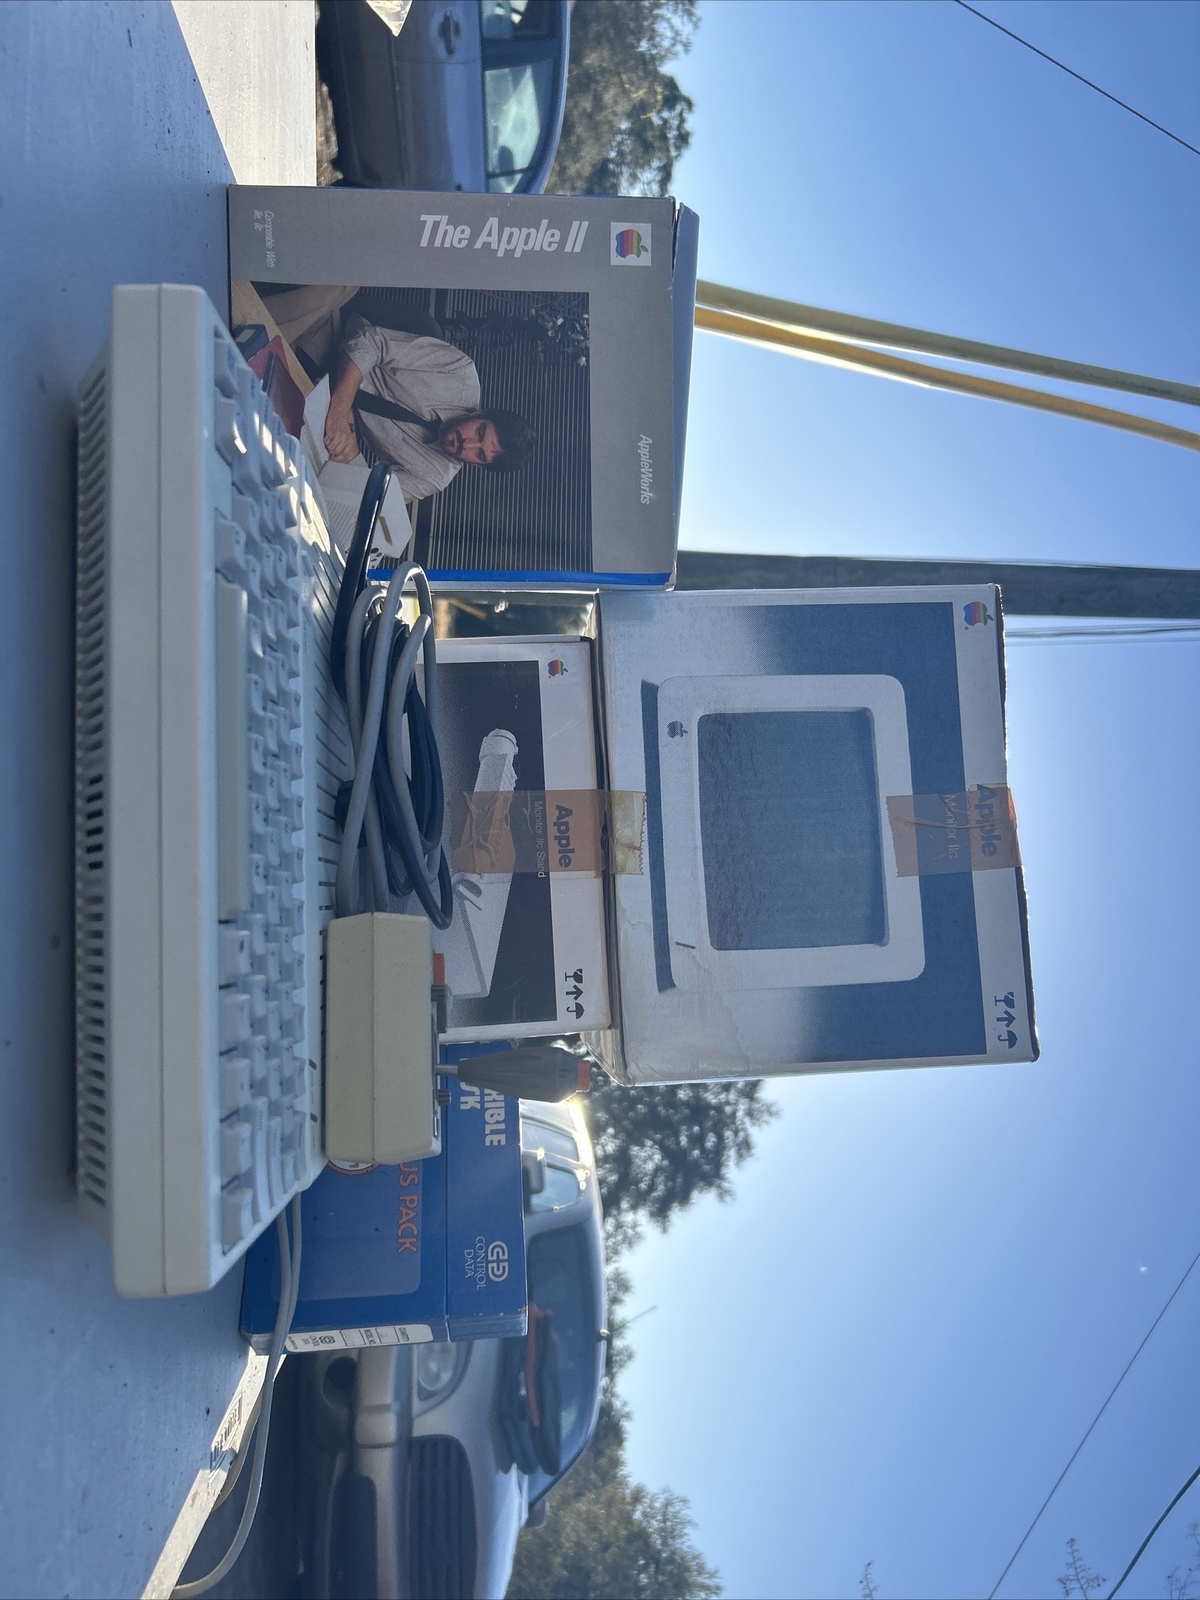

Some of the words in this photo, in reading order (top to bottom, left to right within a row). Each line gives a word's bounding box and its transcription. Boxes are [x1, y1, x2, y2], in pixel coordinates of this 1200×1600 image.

[263, 210, 275, 249] Compatible
[420, 214, 471, 249] The
[474, 217, 561, 258] Apple
[564, 221, 589, 253] II
[265, 251, 276, 268] With
[637, 434, 653, 505] AppleWorks
[534, 801, 543, 834] Monitor
[553, 804, 575, 868] Apple
[945, 795, 958, 840] Monitor
[974, 784, 1002, 857] Apple
[537, 851, 546, 877] Stand
[484, 1088, 506, 1146] XIBLE
[397, 1194, 419, 1254] PACK
[464, 1249, 474, 1278] DATA
[475, 1236, 486, 1290] CONTROL
